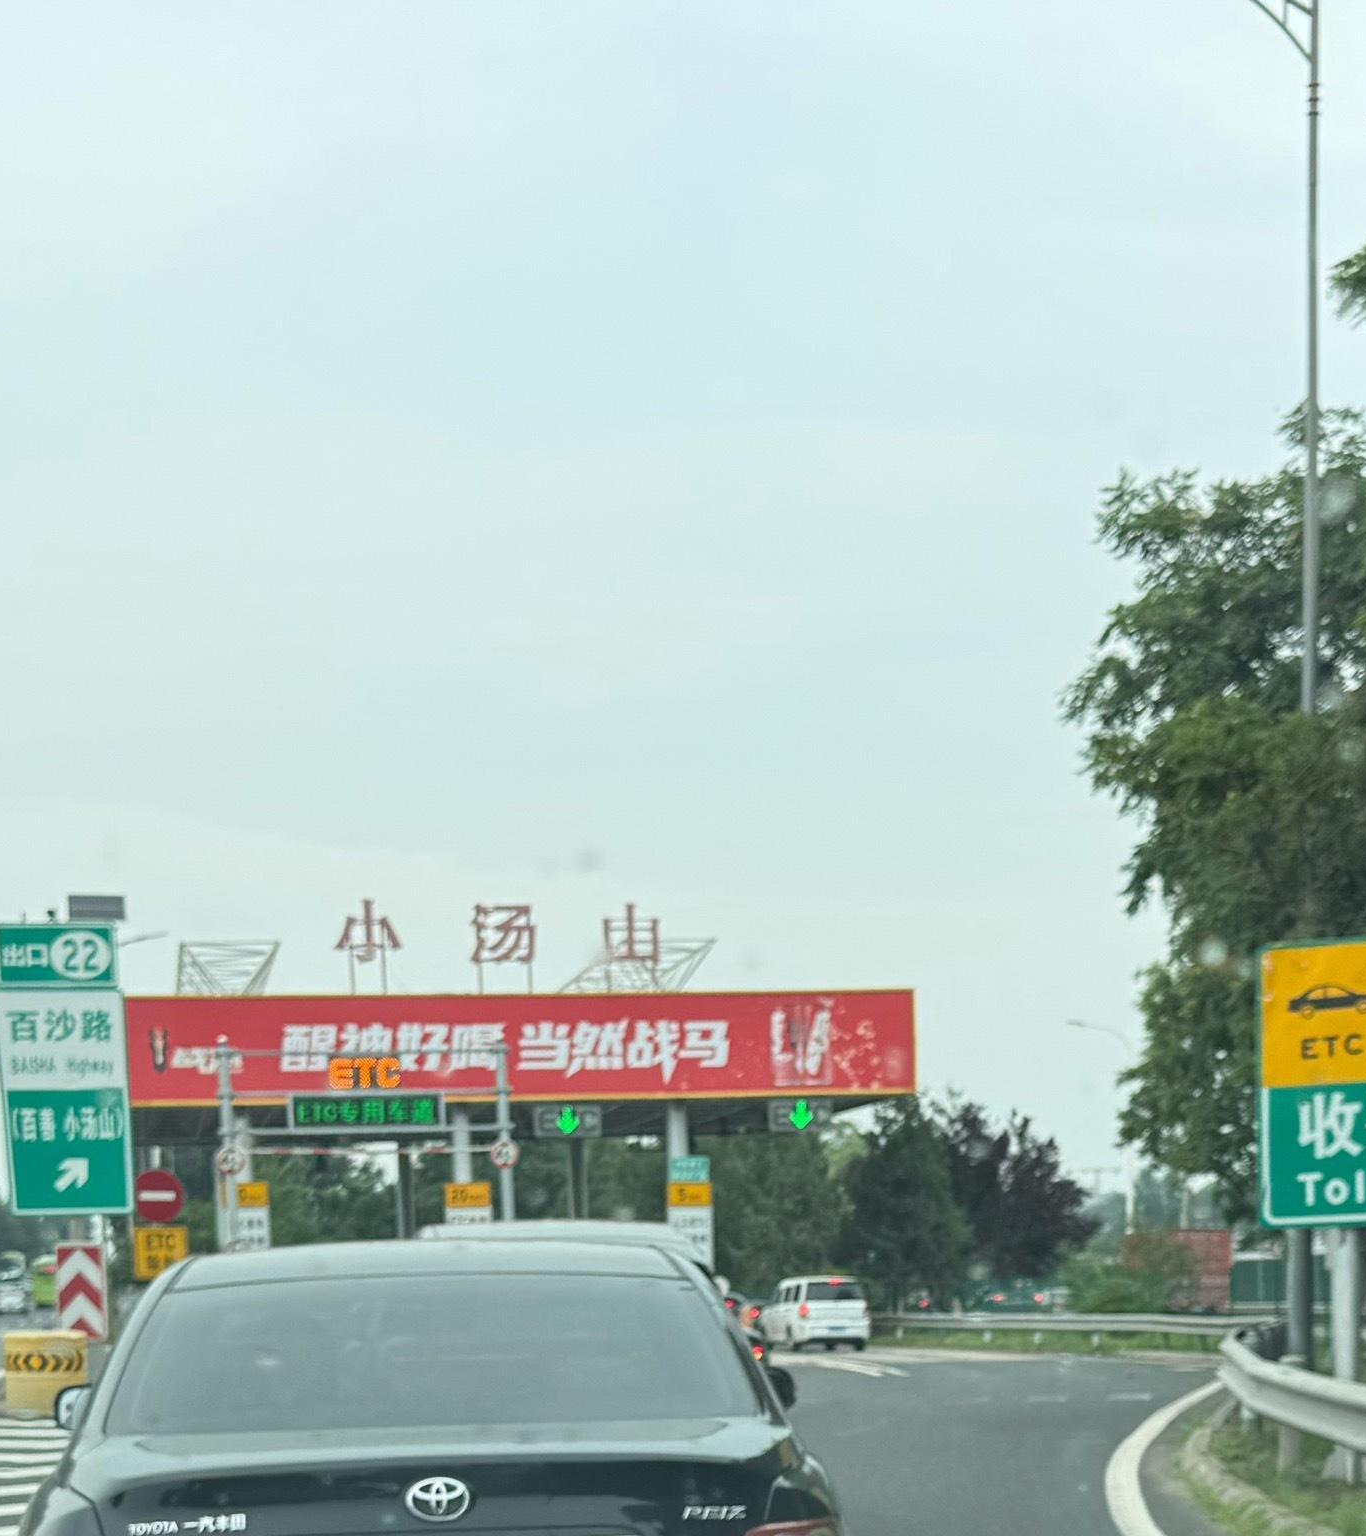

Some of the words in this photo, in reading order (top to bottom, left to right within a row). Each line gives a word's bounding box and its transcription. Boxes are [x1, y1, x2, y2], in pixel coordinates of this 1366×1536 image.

[334, 899, 660, 966] 小汤山
[0, 943, 49, 968] 出口
[62, 938, 100, 972] 22
[5, 1008, 113, 1043] 百沙路
[517, 1016, 731, 1086] 当然战马
[1300, 1033, 1365, 1060] ETC
[328, 1056, 402, 1090] ETC
[145, 1232, 177, 1251] ETC
[128, 1520, 179, 1536] TOYOTA
